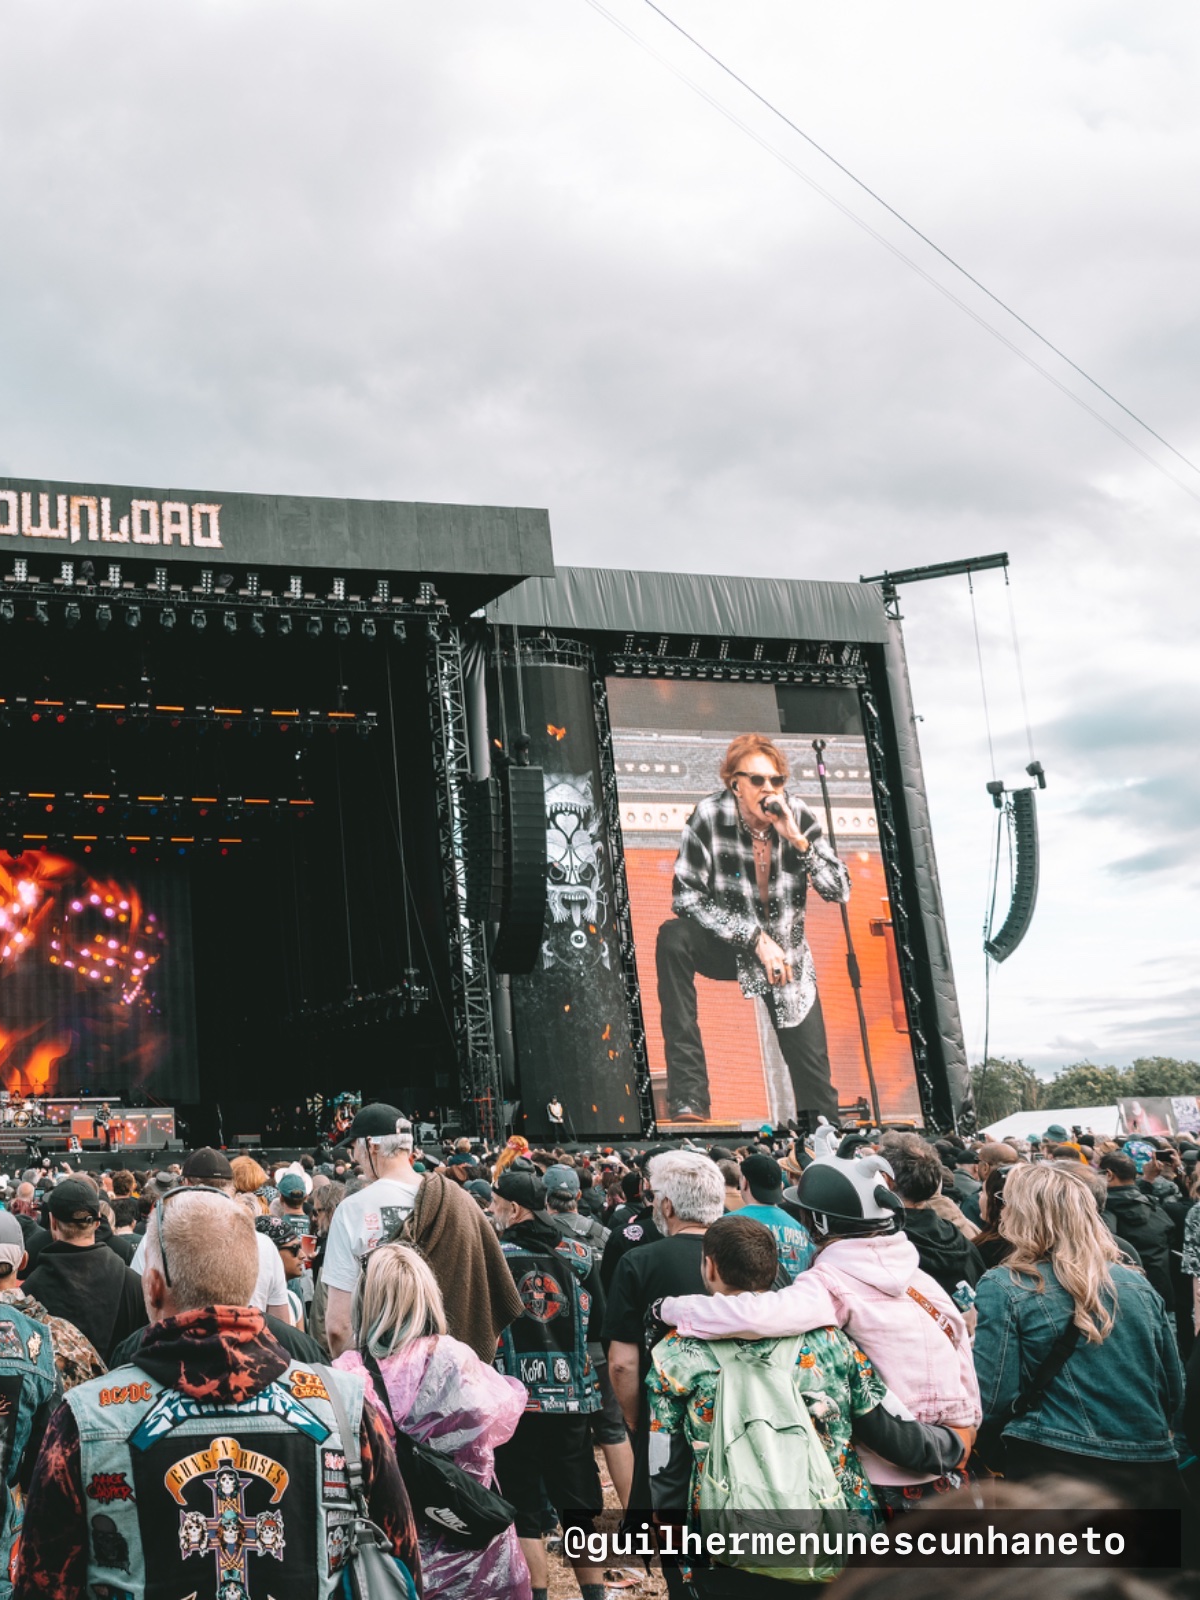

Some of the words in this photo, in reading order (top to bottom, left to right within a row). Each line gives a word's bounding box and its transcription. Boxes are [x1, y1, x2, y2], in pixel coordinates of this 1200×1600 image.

[99, 1380, 152, 1407] AC/DC
[170, 1453, 212, 1485] GUNS
[239, 1452, 285, 1484] ROSES
[436, 1507, 468, 1529] NIKE
